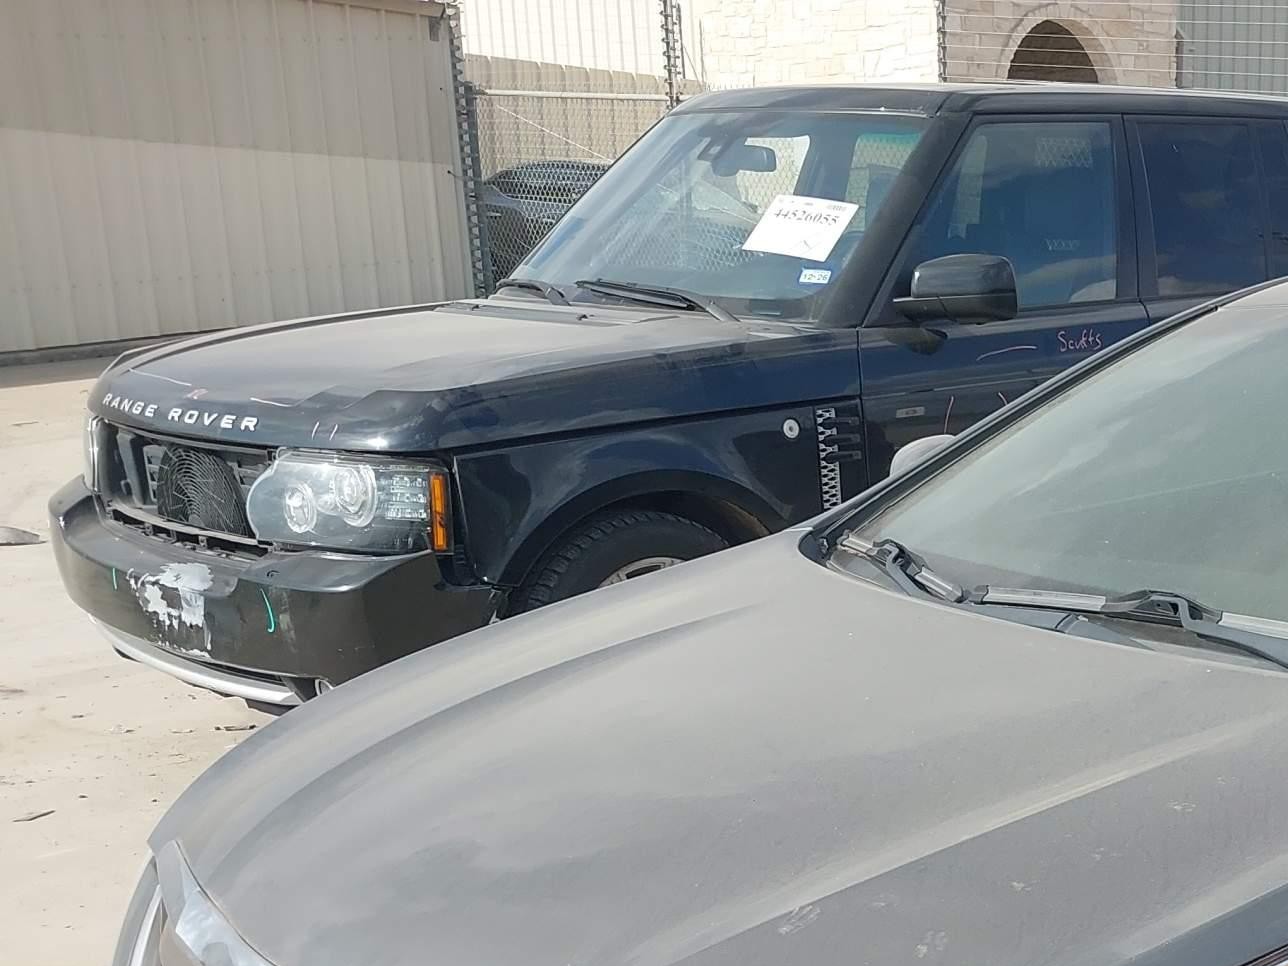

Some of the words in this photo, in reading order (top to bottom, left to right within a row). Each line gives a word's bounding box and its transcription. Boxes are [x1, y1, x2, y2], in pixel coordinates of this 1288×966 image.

[774, 207, 841, 226] 44526055
[102, 392, 160, 418] RANGE
[167, 407, 260, 432] ROVER
